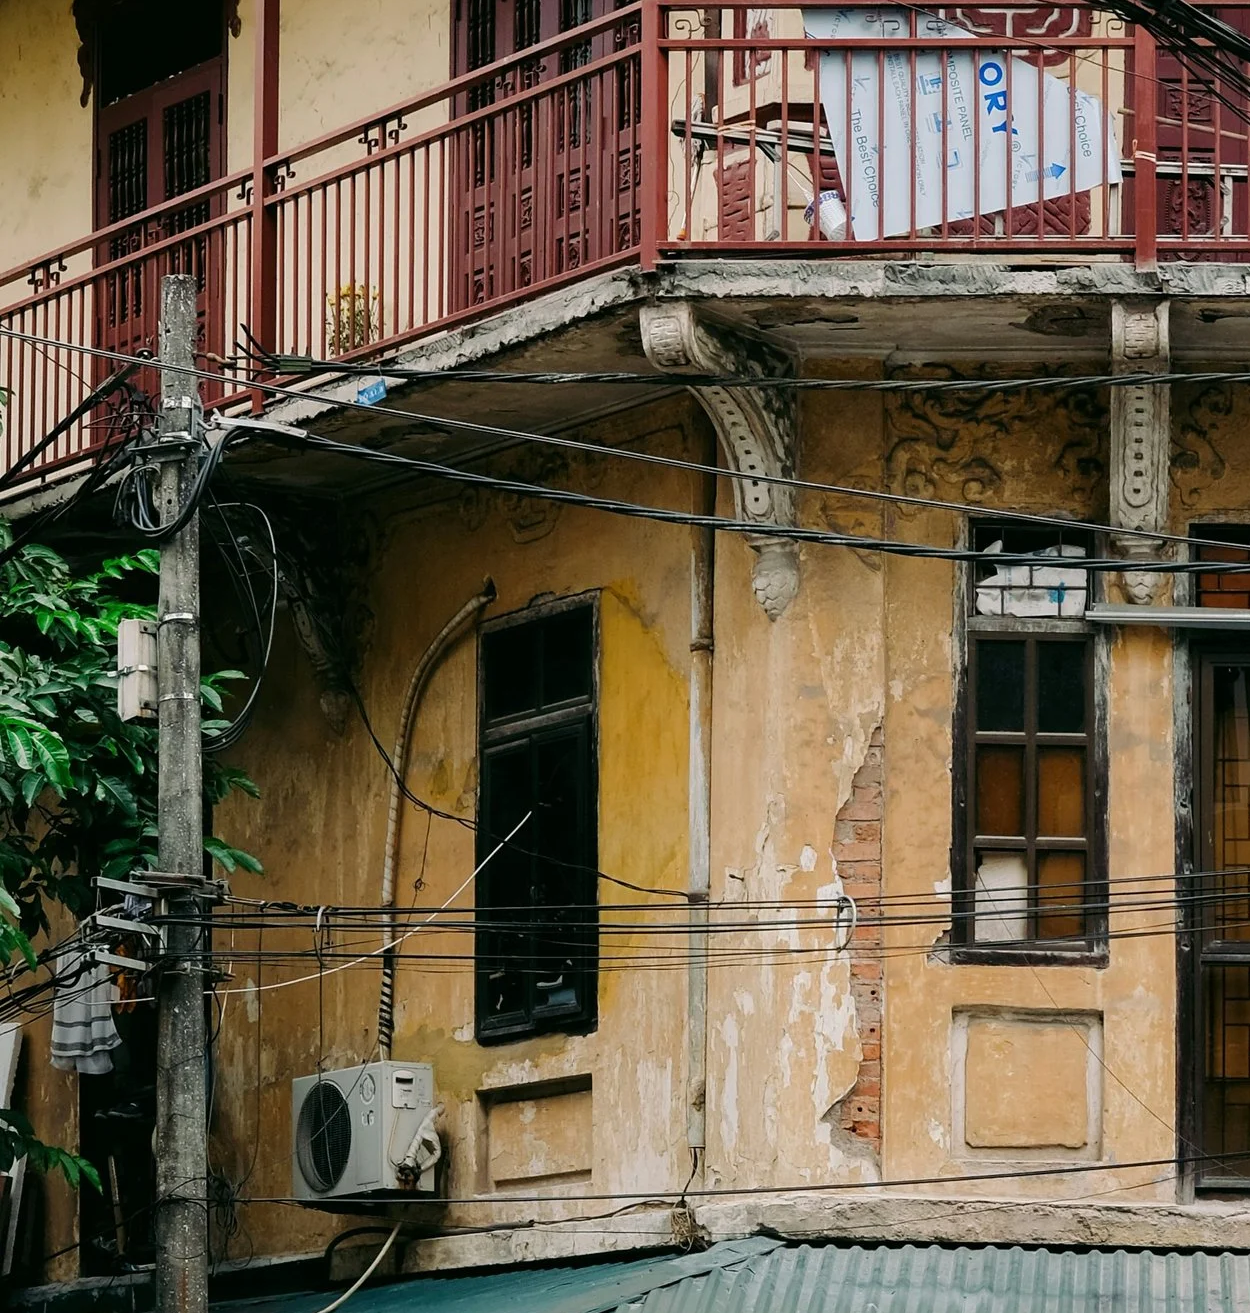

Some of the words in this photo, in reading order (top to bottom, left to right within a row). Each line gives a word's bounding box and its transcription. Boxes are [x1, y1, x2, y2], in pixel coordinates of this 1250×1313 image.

[850, 109, 864, 133] The
[957, 105, 973, 141] PANEL
[1074, 114, 1093, 158] Choice
[856, 135, 872, 164] Best
